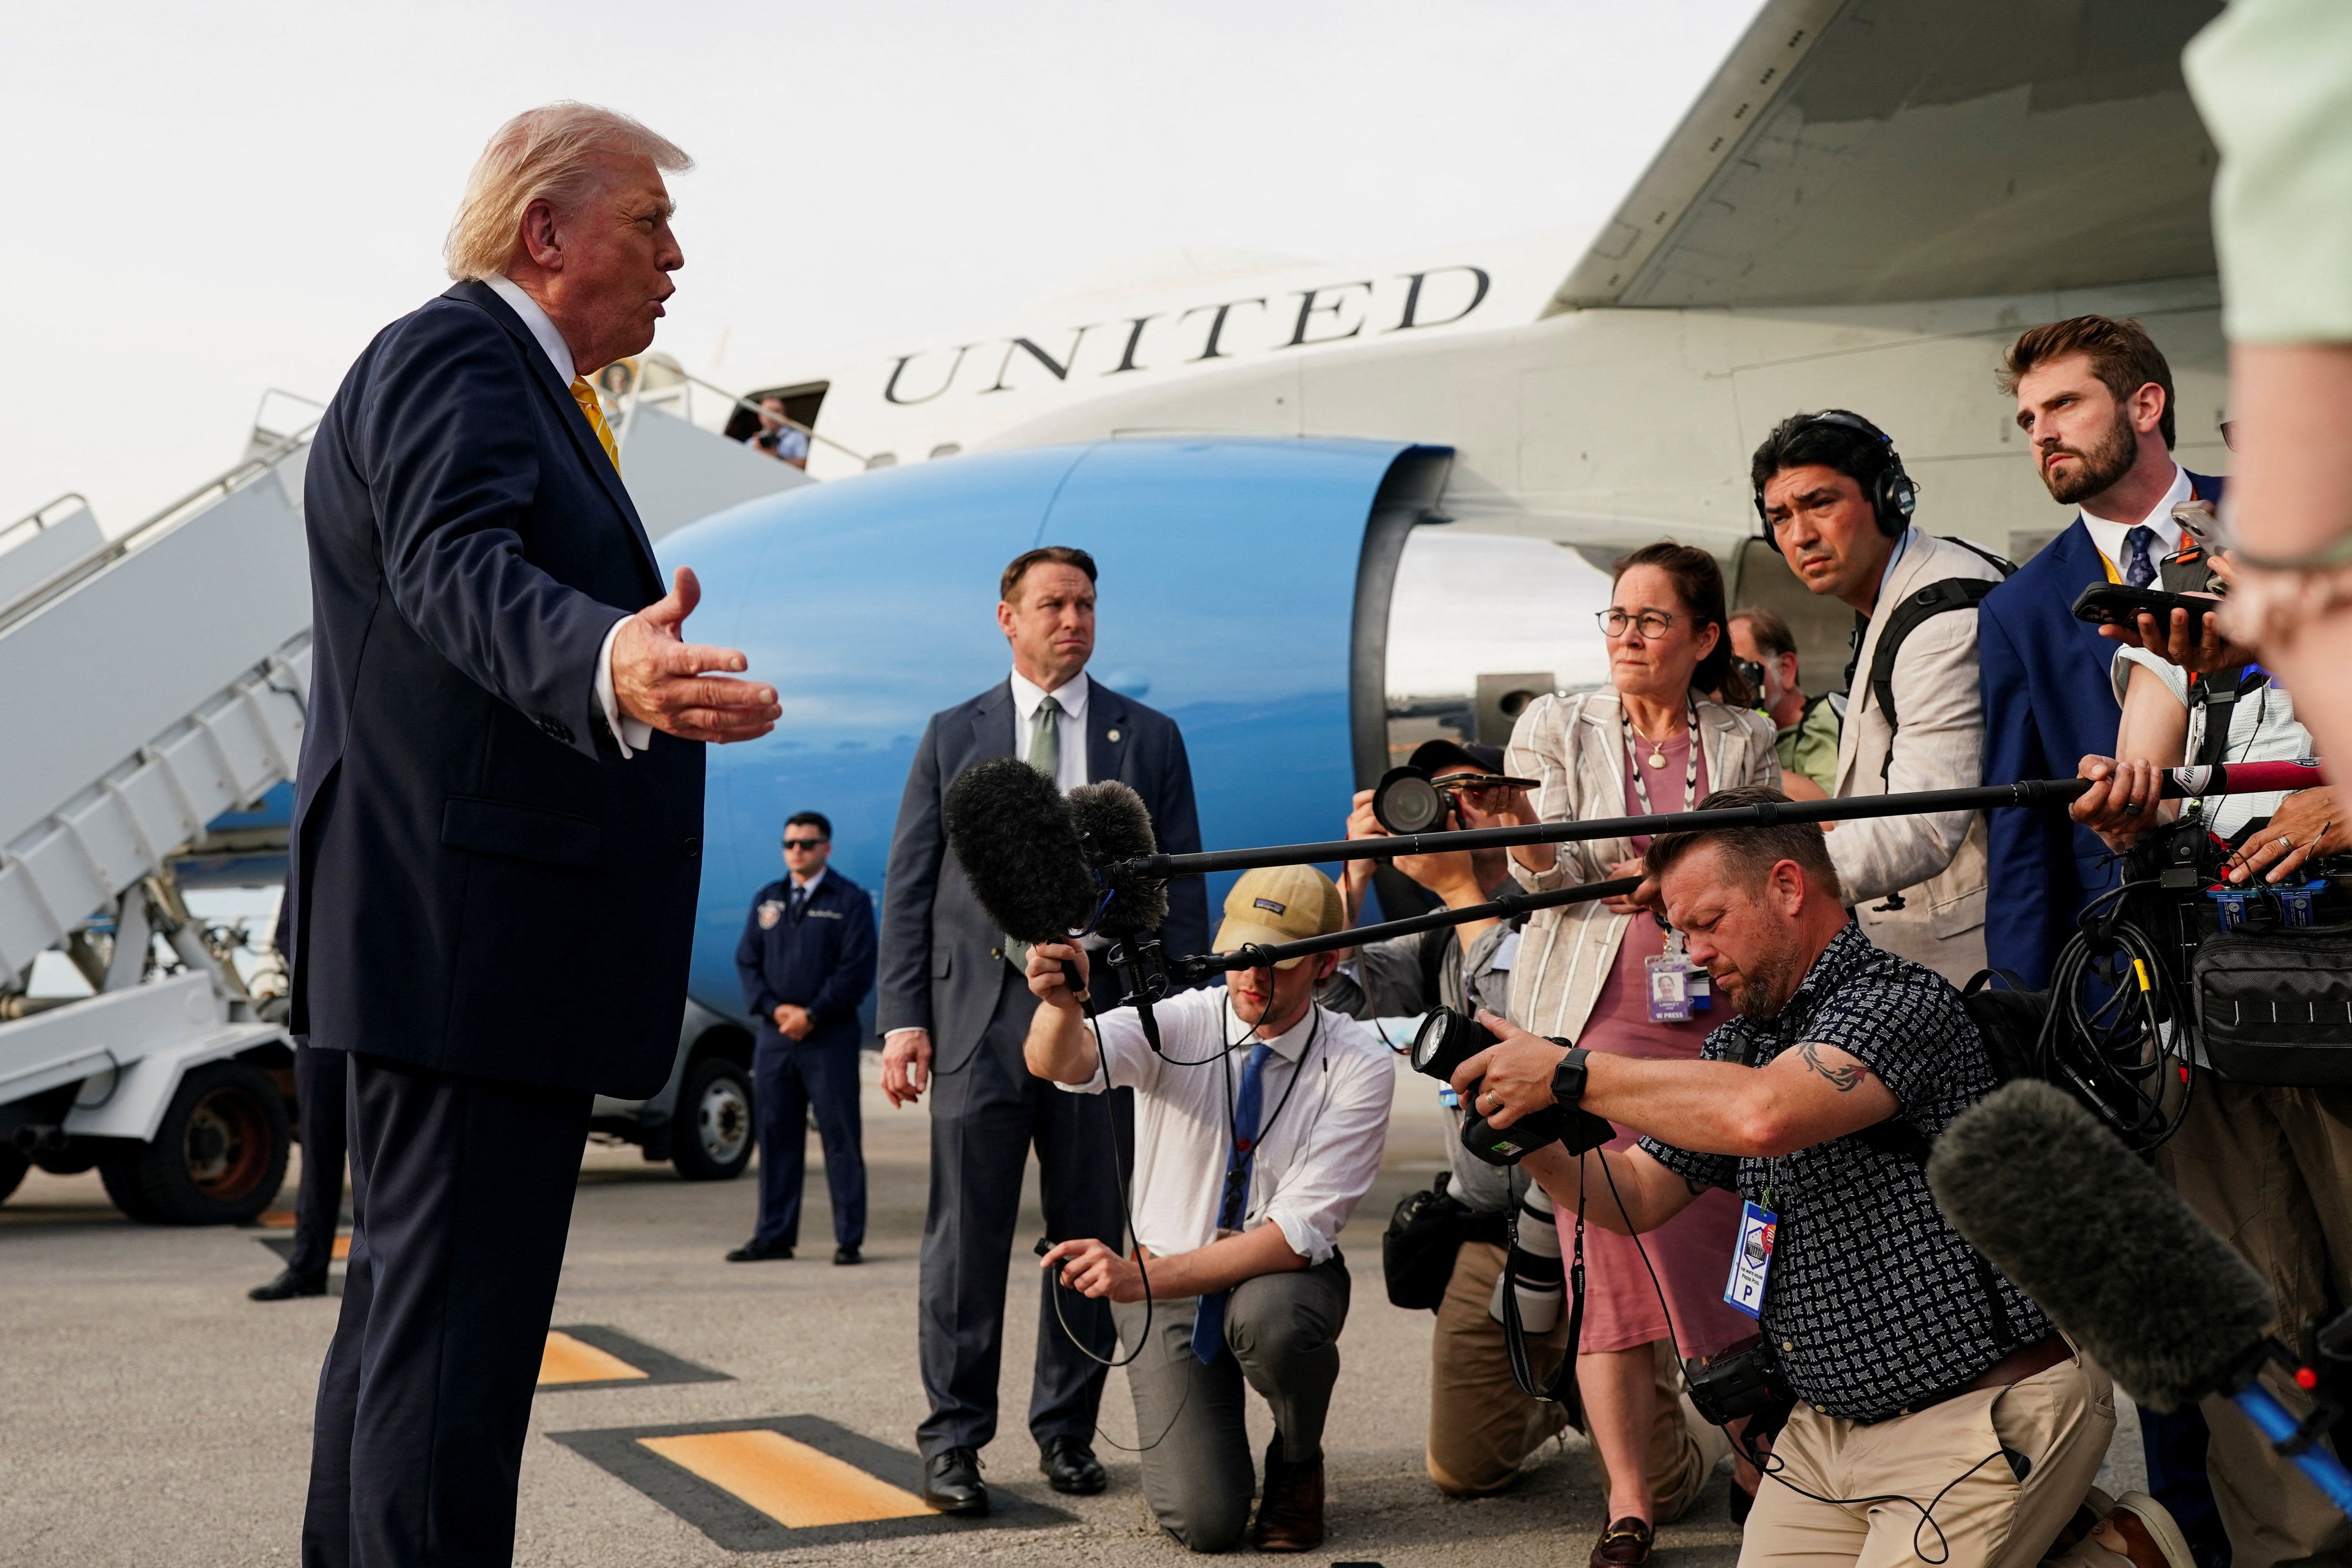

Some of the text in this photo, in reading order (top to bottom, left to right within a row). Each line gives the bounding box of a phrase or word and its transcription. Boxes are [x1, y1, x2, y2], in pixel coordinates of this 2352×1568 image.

[883, 265, 1492, 405] UNITED
[1766, 1227, 1775, 1244] 103
[1743, 1284, 1753, 1301] P
